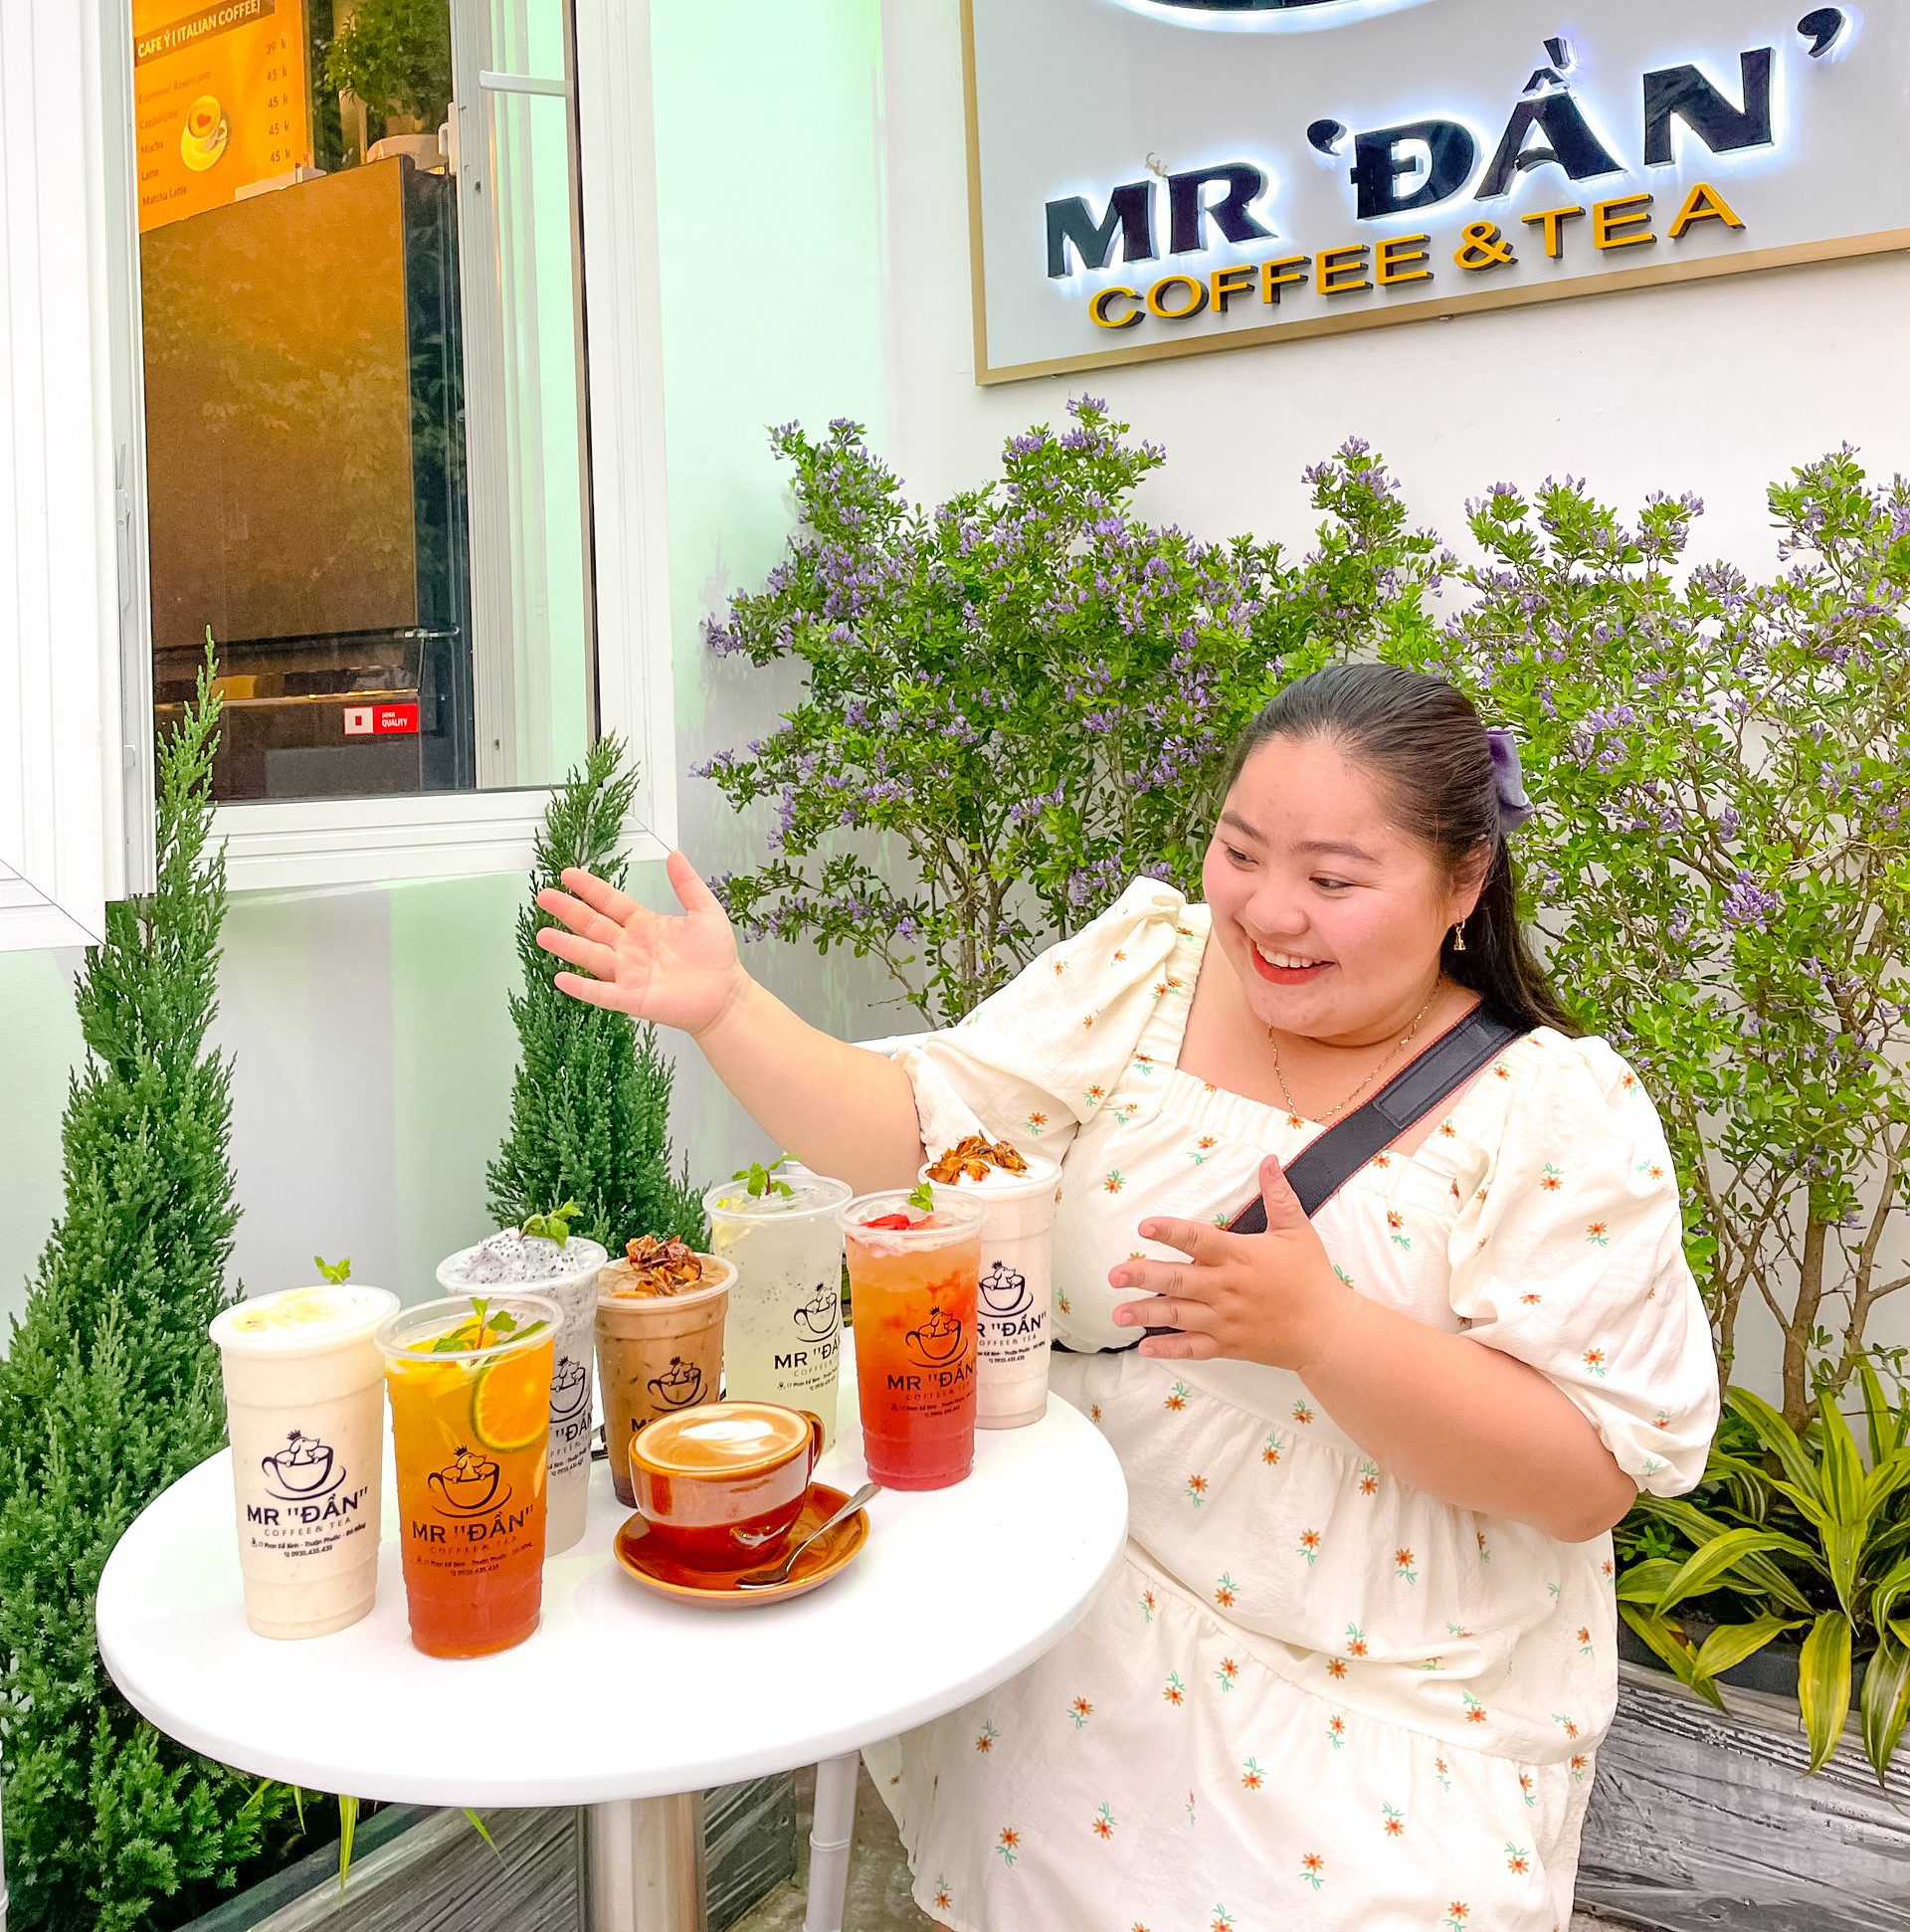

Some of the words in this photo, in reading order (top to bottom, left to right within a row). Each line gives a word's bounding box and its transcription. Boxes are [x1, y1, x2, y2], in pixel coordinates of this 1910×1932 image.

[137, 36, 163, 58] CAFE
[267, 69, 278, 82] 45
[268, 96, 279, 108] 45
[269, 122, 280, 135] 45
[270, 150, 281, 163] 45
[1045, 161, 1279, 280] MR
[1088, 233, 1434, 330] COFFEE
[1453, 220, 1519, 272] &
[1520, 182, 1747, 259] TEA
[381, 717, 408, 728] QUALITY
[977, 1322, 986, 1338] R
[774, 1351, 808, 1371] MR
[886, 1374, 922, 1391] MR
[247, 1503, 281, 1526] MR
[329, 1516, 351, 1530] TEA
[412, 1519, 447, 1544] MR
